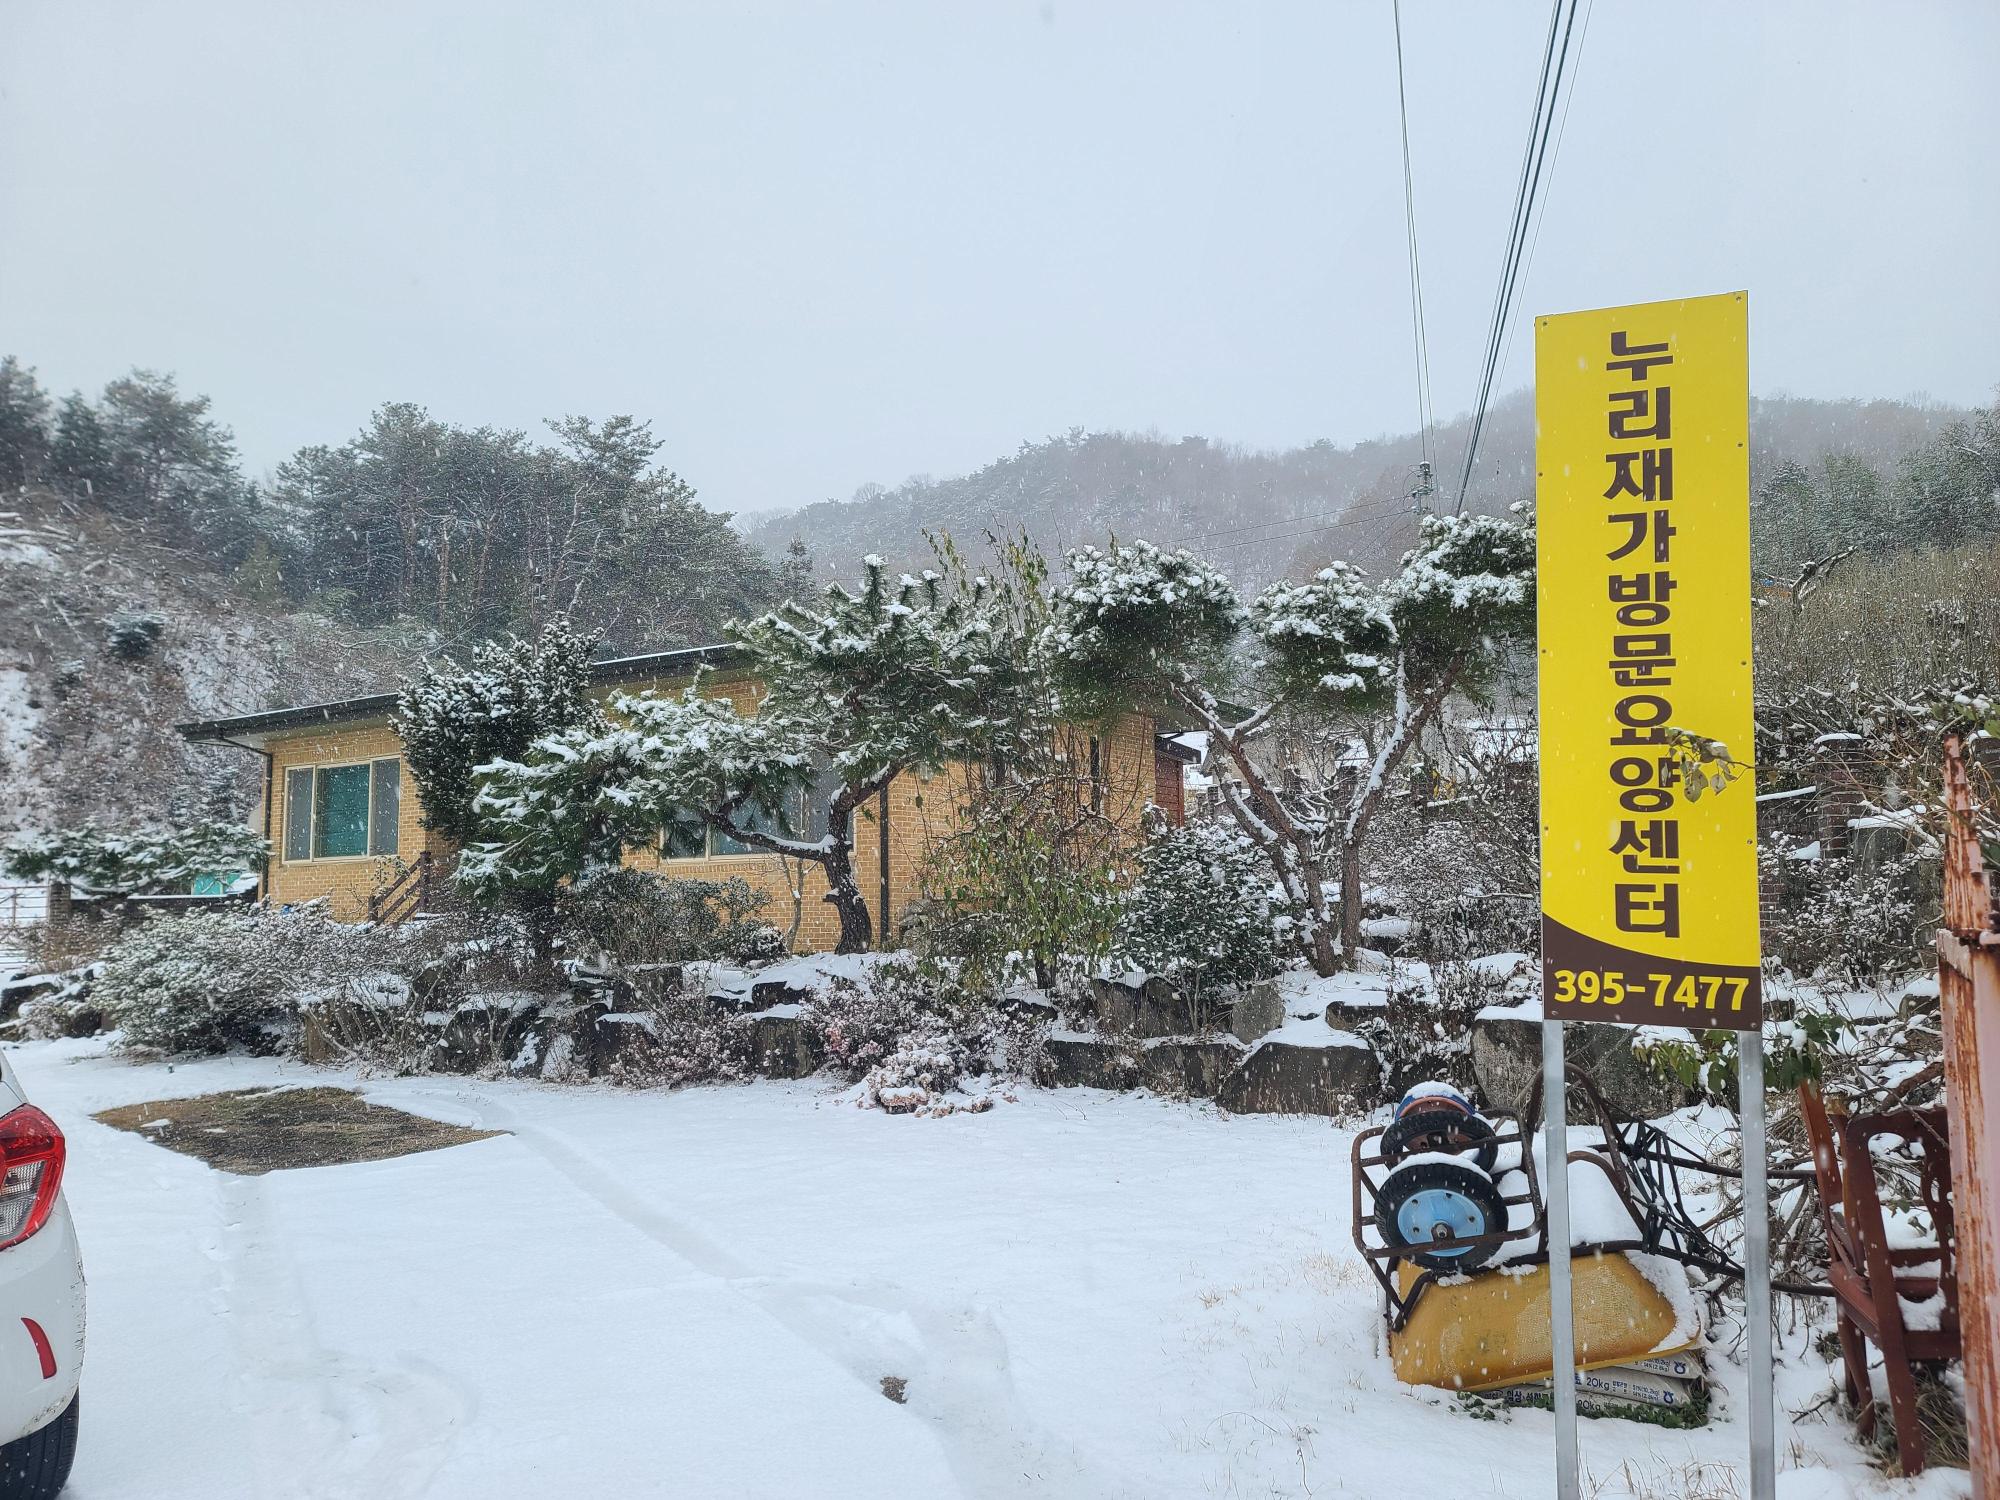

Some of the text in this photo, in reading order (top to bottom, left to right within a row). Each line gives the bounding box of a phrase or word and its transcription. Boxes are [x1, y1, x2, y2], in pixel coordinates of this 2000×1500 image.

[1603, 331, 1680, 938] 누리재가방문요양센터
[1554, 970, 1749, 1011] 395-7477
[1586, 1377, 1610, 1392] 20kg
